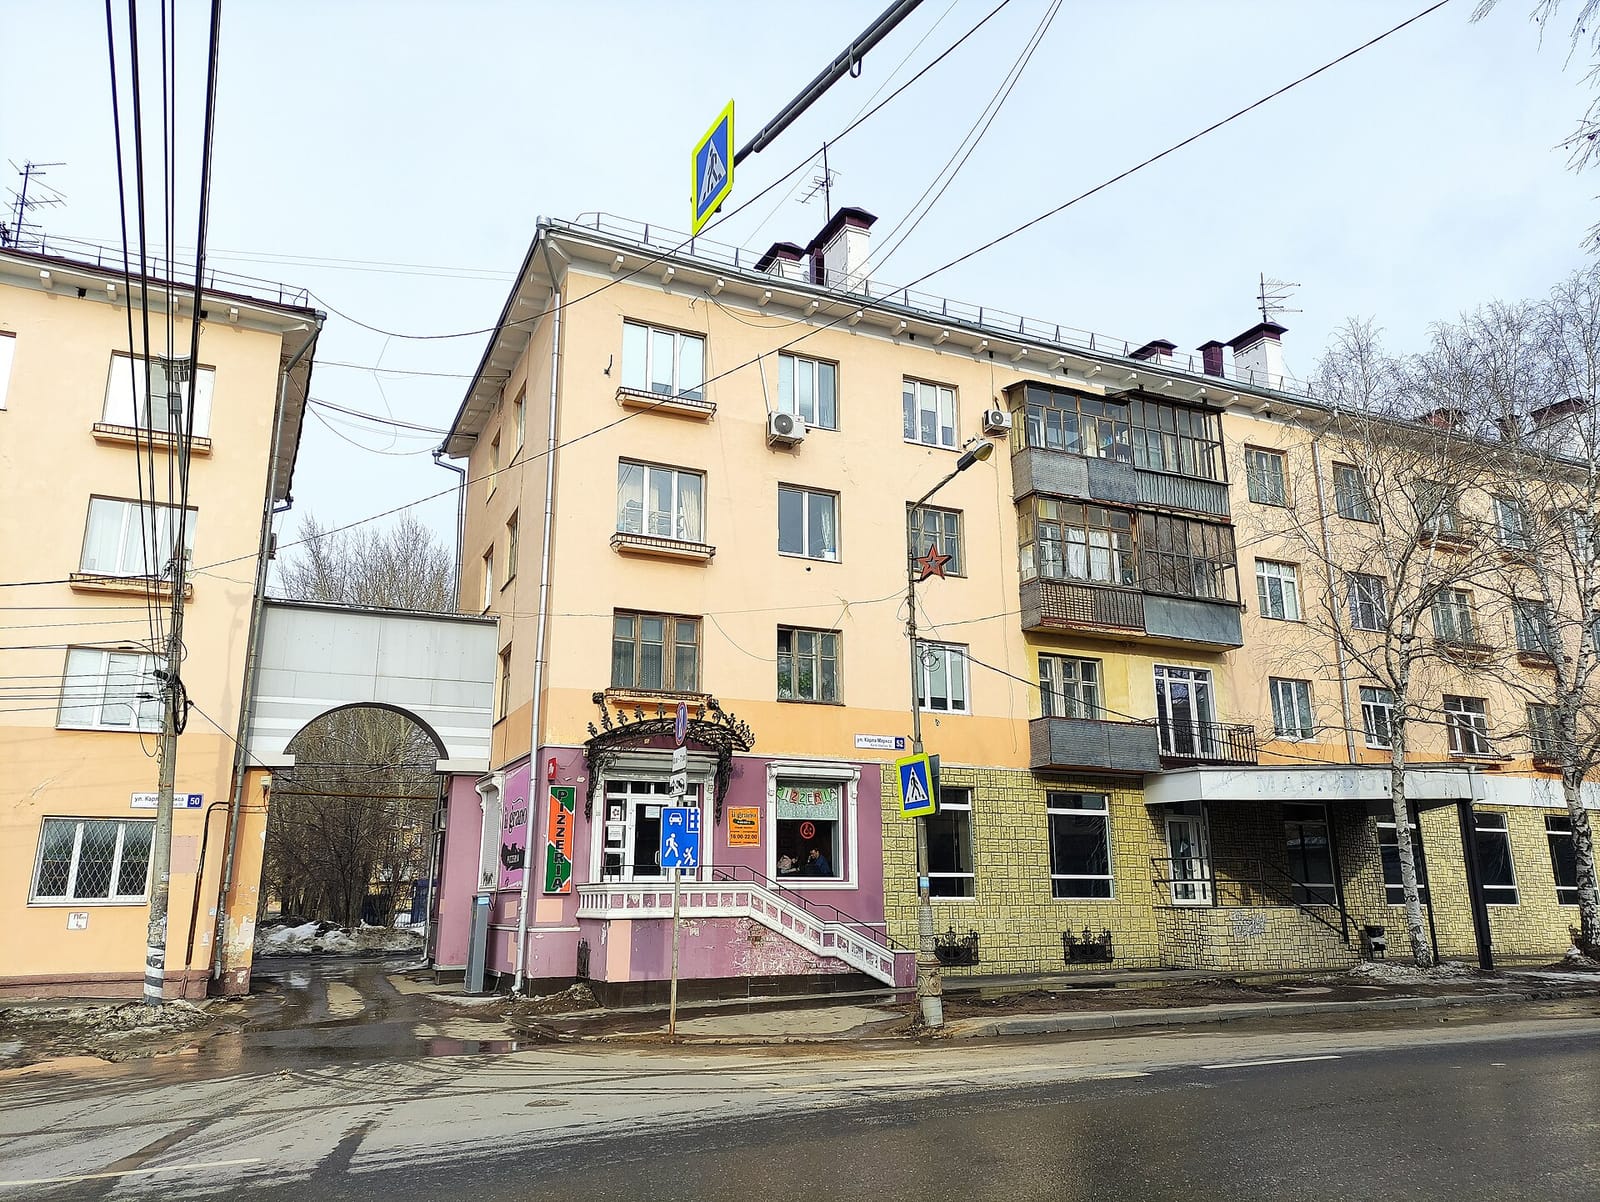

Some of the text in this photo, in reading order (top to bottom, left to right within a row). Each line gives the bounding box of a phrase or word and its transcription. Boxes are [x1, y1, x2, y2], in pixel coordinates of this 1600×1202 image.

[895, 739, 904, 748] 52
[189, 797, 200, 805] 50
[552, 790, 568, 889] PIZZERIA
